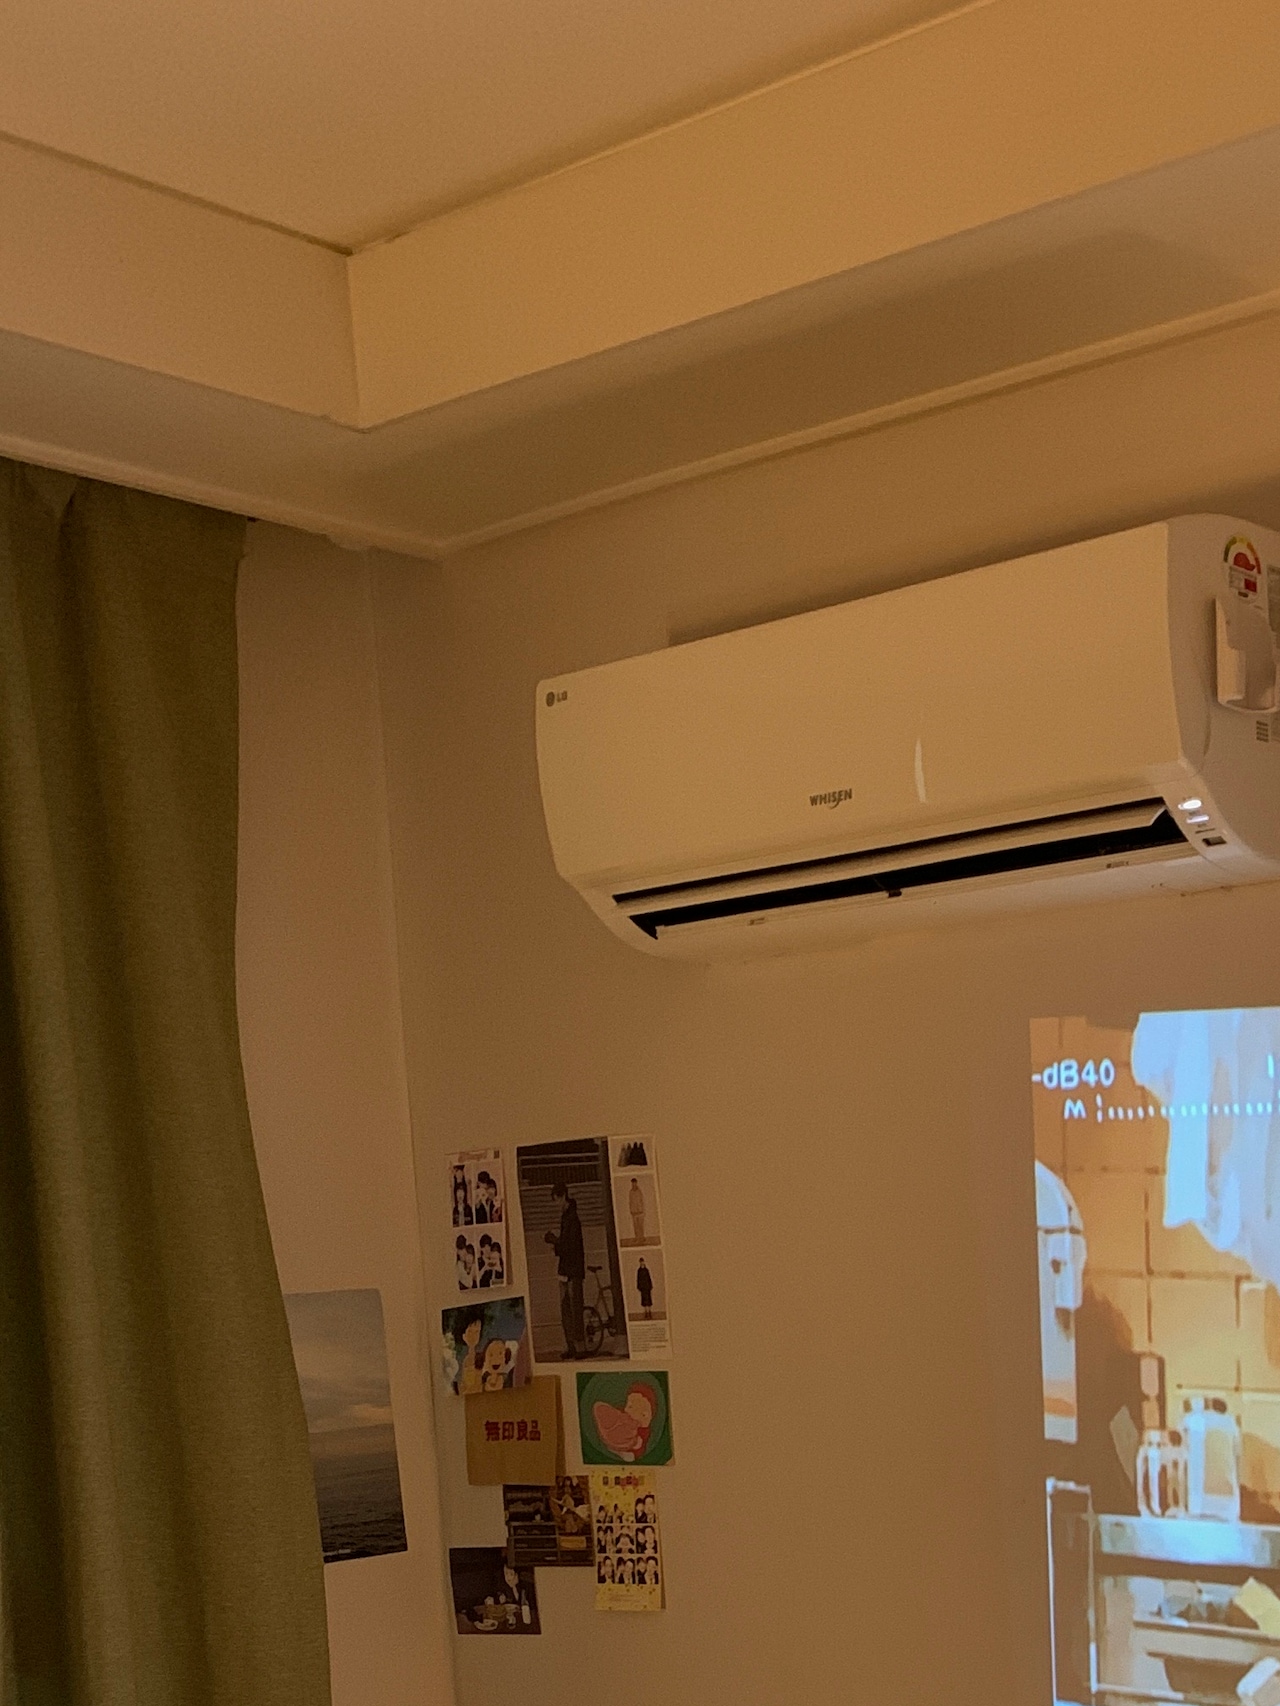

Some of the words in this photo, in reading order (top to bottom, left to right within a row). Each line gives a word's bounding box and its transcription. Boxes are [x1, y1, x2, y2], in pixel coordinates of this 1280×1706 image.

[809, 788, 852, 810] WHISEN
[1063, 1097, 1087, 1120] M
[484, 1419, 541, 1441] 無印良品
